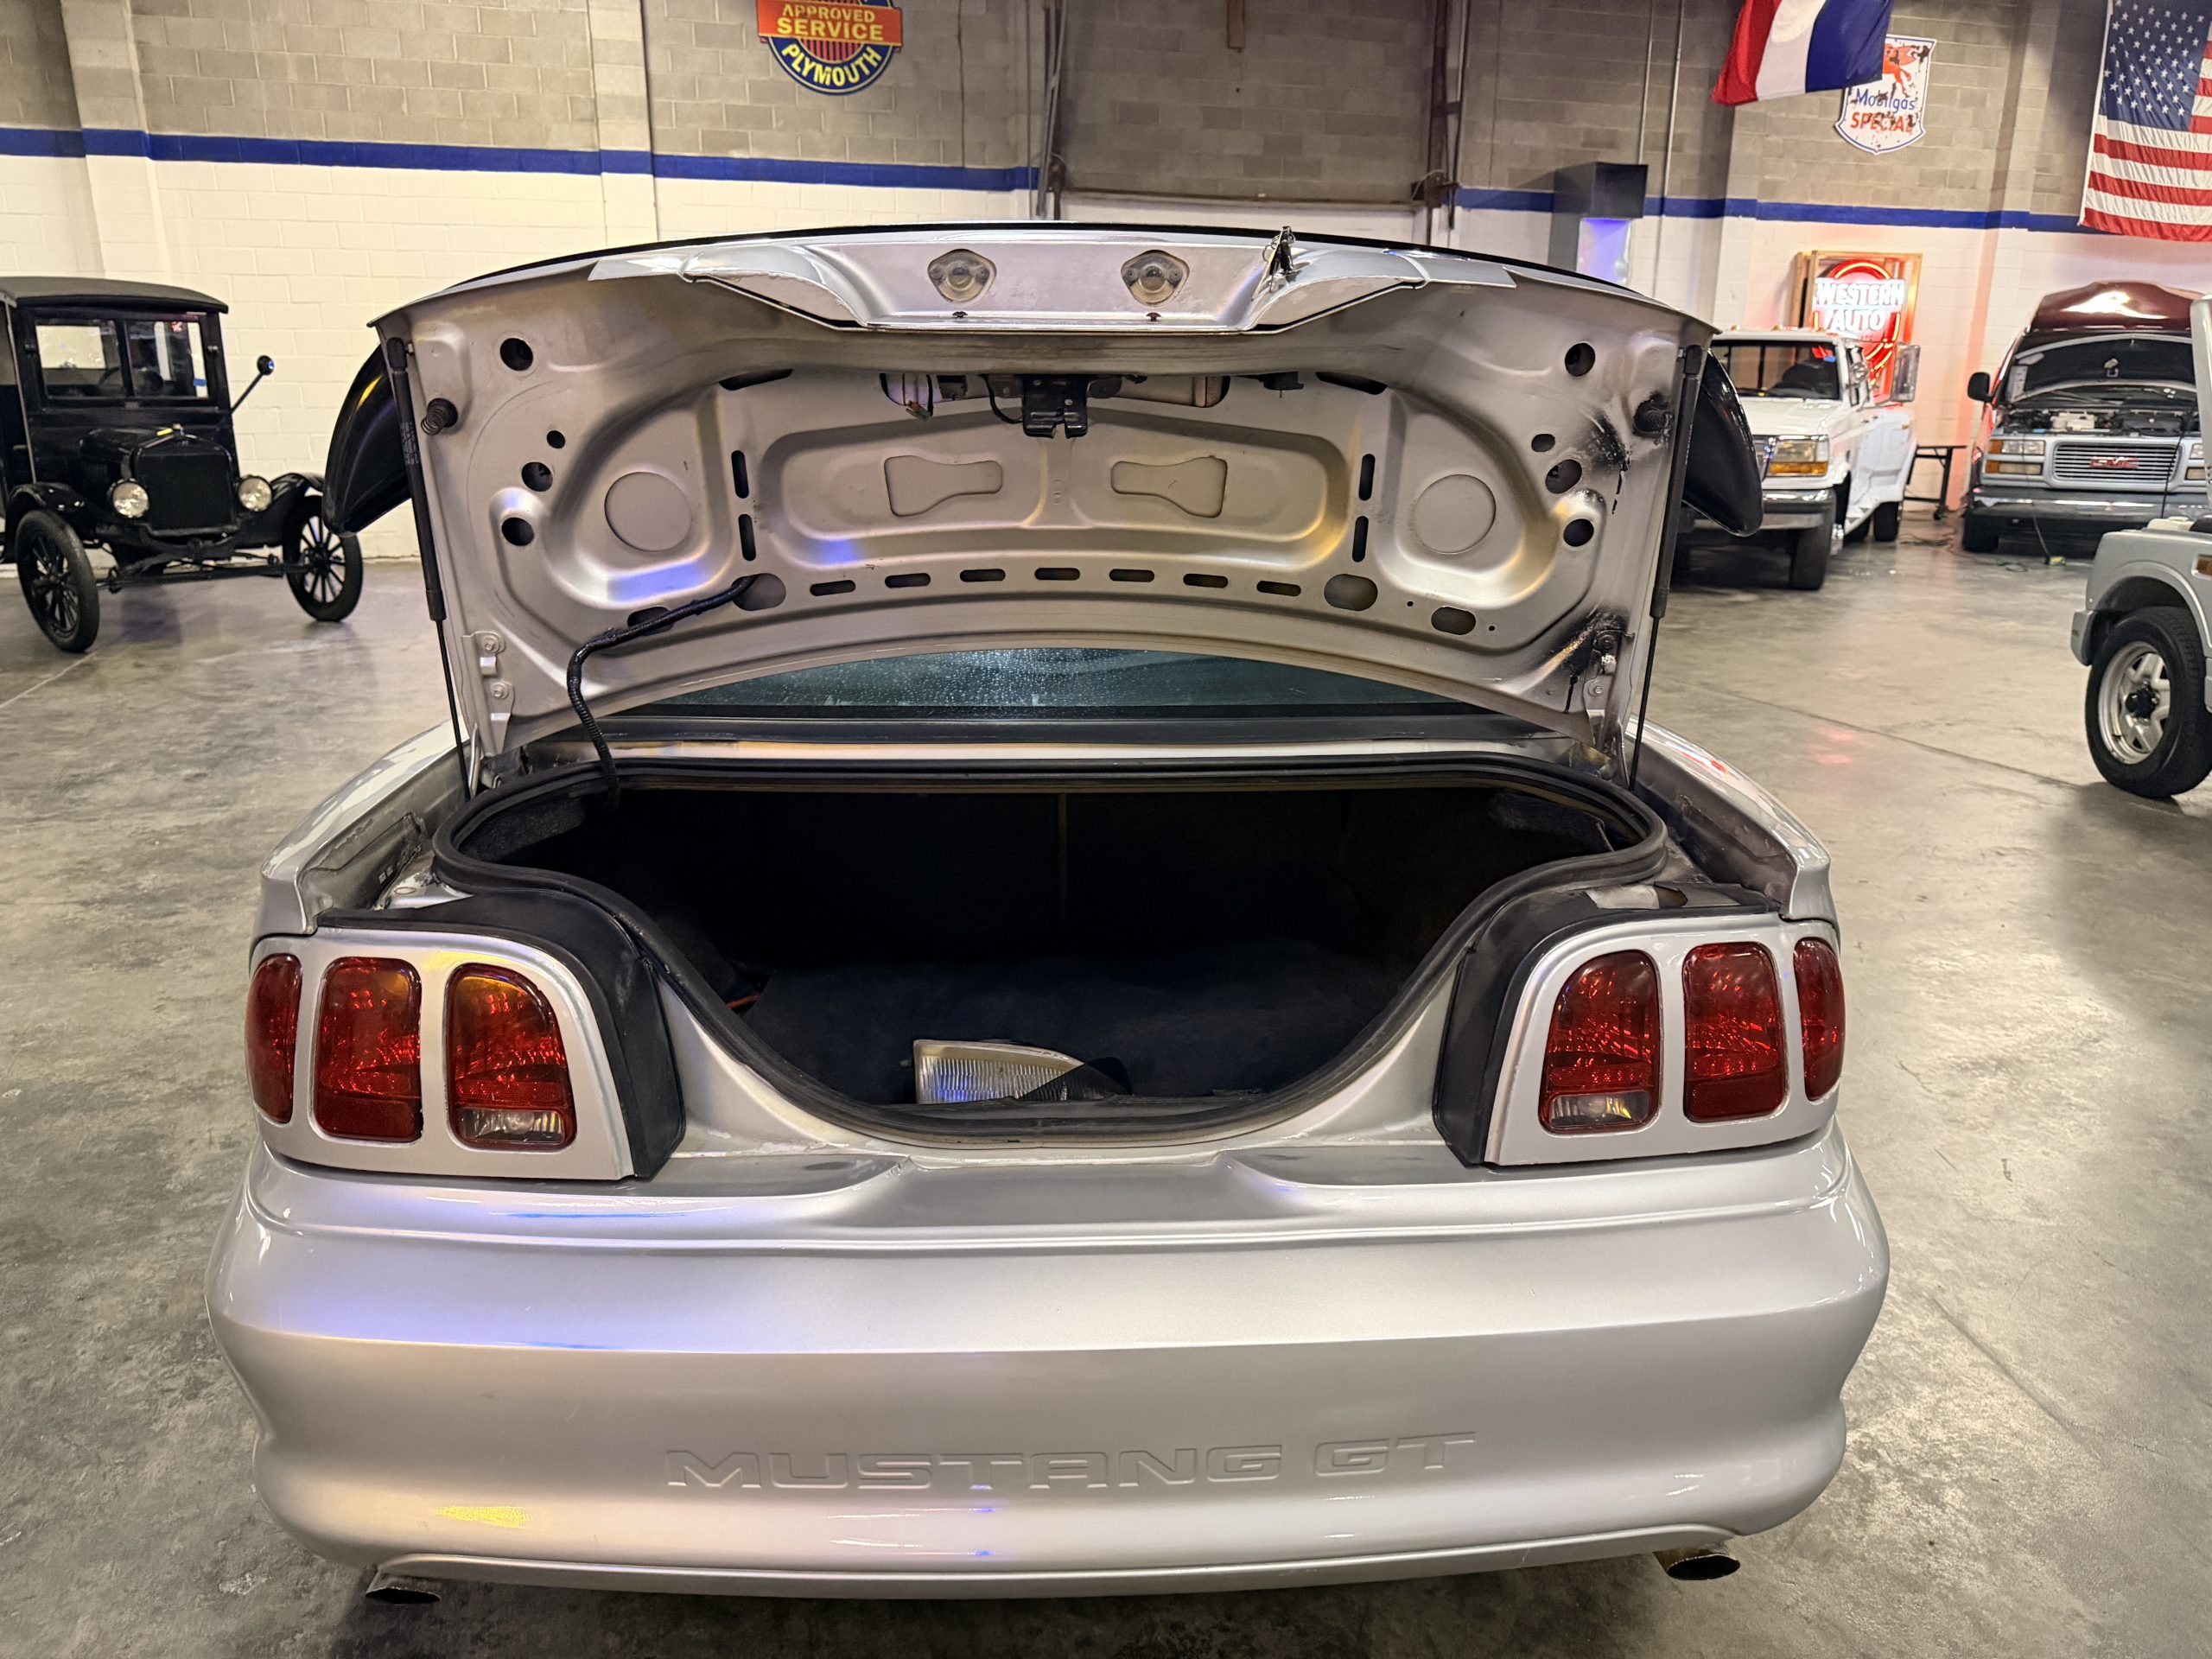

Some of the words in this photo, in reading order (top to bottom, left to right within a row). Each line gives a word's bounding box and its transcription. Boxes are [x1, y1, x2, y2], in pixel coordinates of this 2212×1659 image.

[783, 3, 875, 22] APPROVED
[778, 17, 883, 41] SERVICE
[781, 44, 882, 86] PLYMOUTH
[1815, 283, 1904, 306] WESTERN
[1824, 308, 1887, 332] AUTO
[665, 1444, 1282, 1490] MUSTANG
[1314, 1431, 1476, 1477] GT
